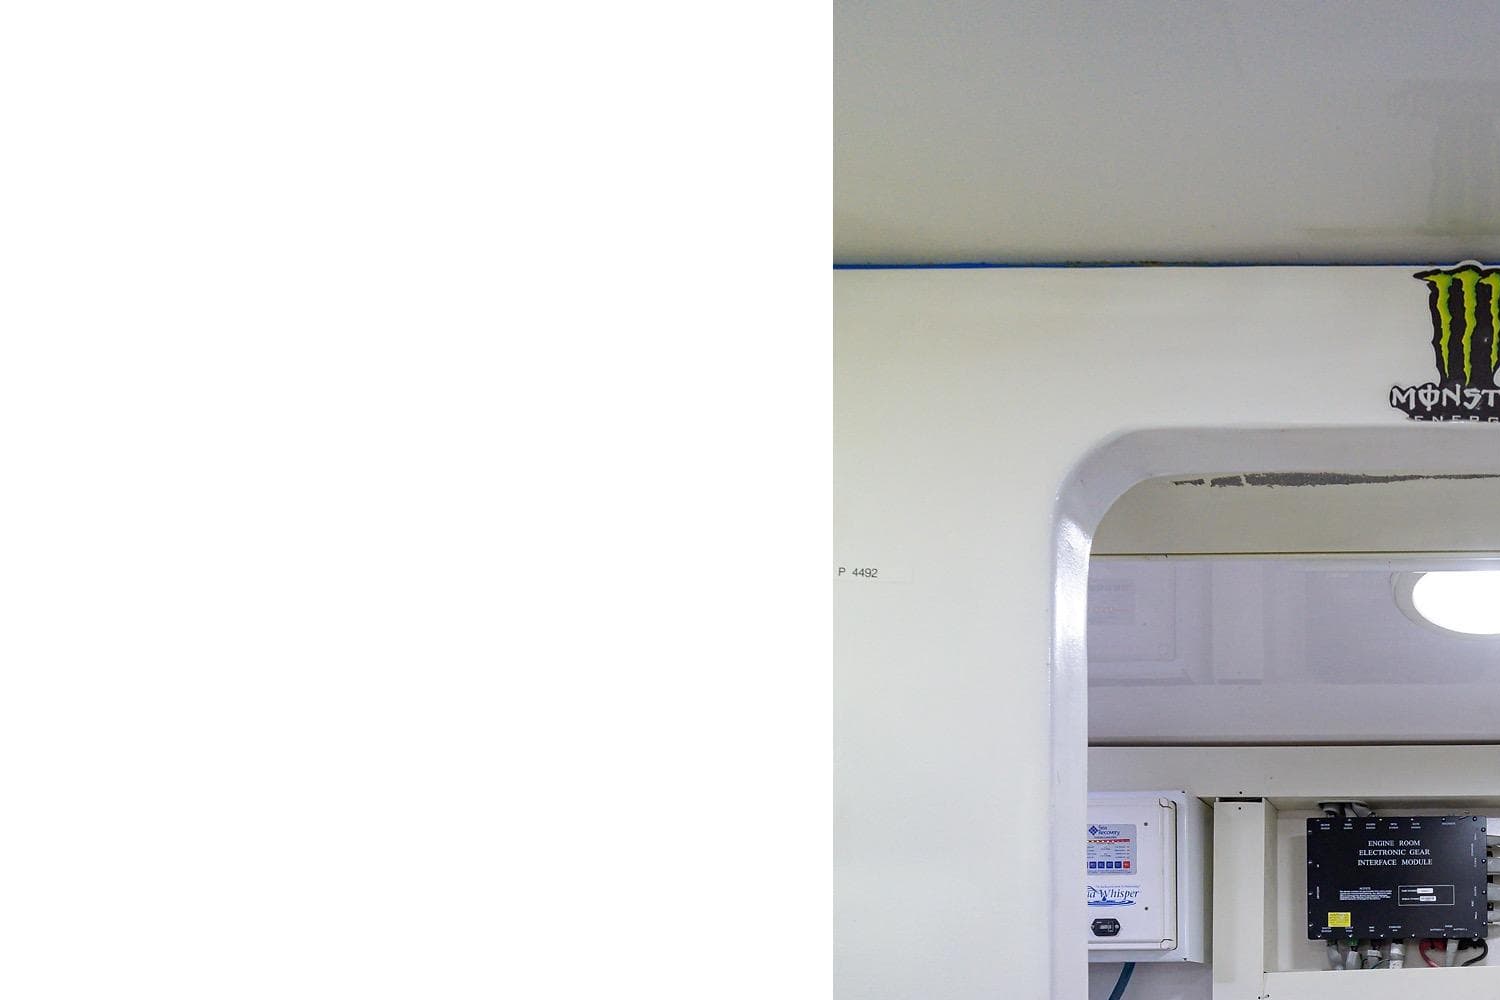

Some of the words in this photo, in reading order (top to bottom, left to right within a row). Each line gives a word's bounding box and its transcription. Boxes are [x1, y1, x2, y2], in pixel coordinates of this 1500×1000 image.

[838, 567, 846, 577] P
[851, 567, 878, 578] 4492
[1398, 839, 1421, 847] ROOM
[1099, 889, 1139, 900] Whisper
